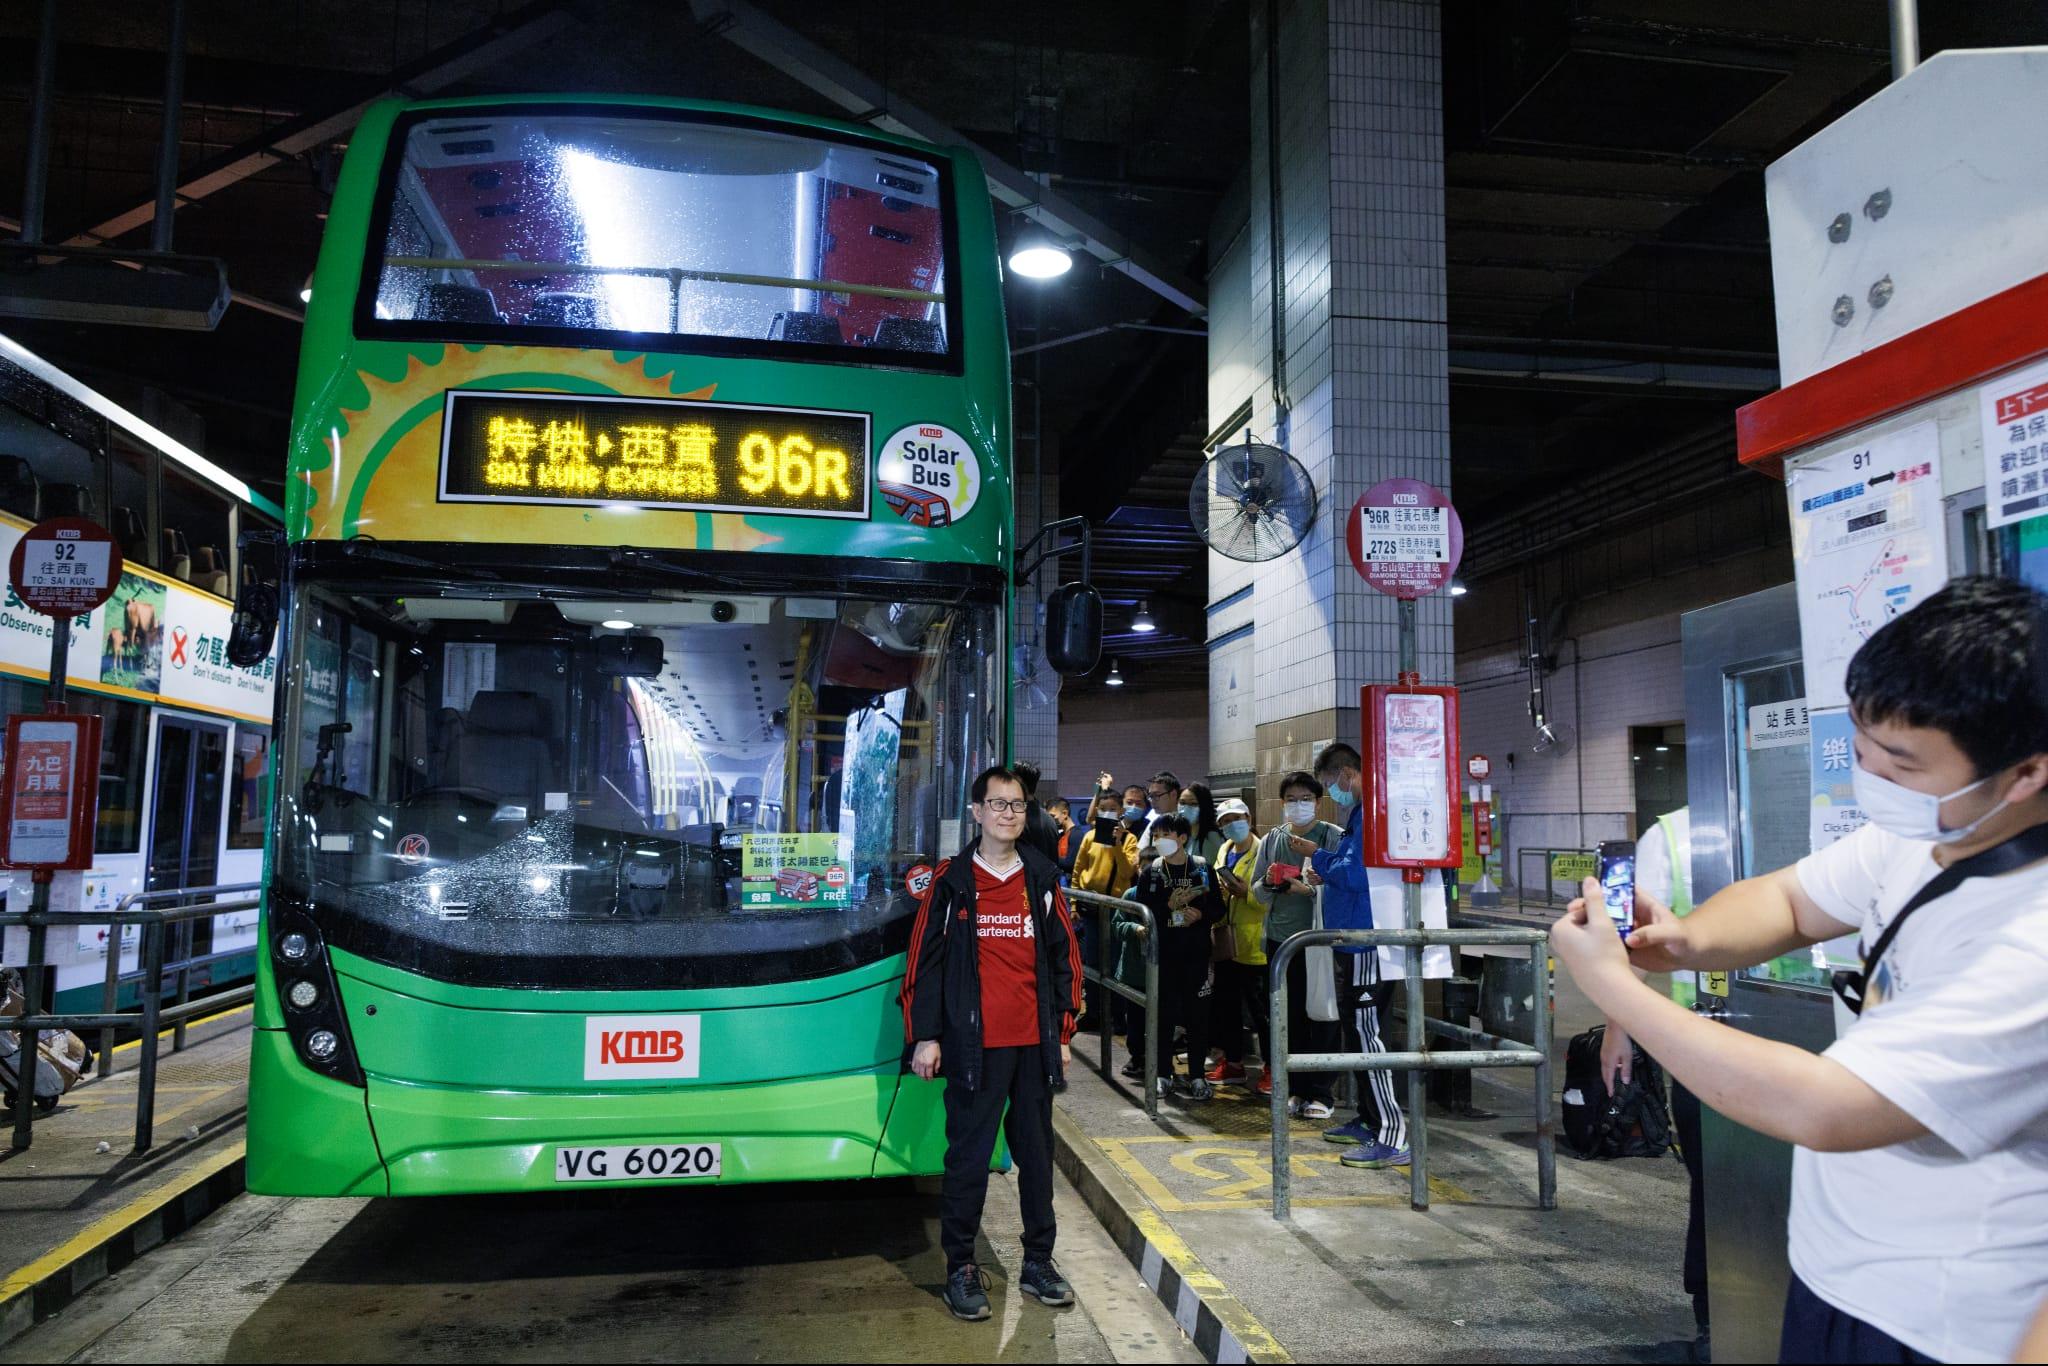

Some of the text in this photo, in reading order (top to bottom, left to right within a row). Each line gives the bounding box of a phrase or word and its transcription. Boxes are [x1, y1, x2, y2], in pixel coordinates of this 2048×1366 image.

[919, 427, 943, 438] KMB
[2009, 414, 2048, 444] 為保
[488, 416, 718, 464] 特快 西貢
[903, 440, 960, 466] Solar
[1853, 450, 1871, 470] 91
[738, 432, 850, 499] 96R
[486, 462, 531, 487] SAI
[537, 463, 601, 492] KUNG
[912, 463, 951, 488] Bus
[1393, 494, 1419, 504] KMB
[1369, 510, 1390, 524] 96R
[56, 529, 80, 539] KMB
[55, 543, 76, 560] 92
[1371, 540, 1397, 555] 272S
[41, 562, 88, 575] 往西貢
[51, 577, 66, 585] SAI
[69, 577, 95, 585] KUNG
[0, 612, 43, 636] Observe
[26, 755, 62, 772] 九巴
[824, 891, 847, 901] FREE
[976, 912, 1021, 924] tandard
[601, 1030, 684, 1064] KMB
[563, 1146, 714, 1177] VG 6020
